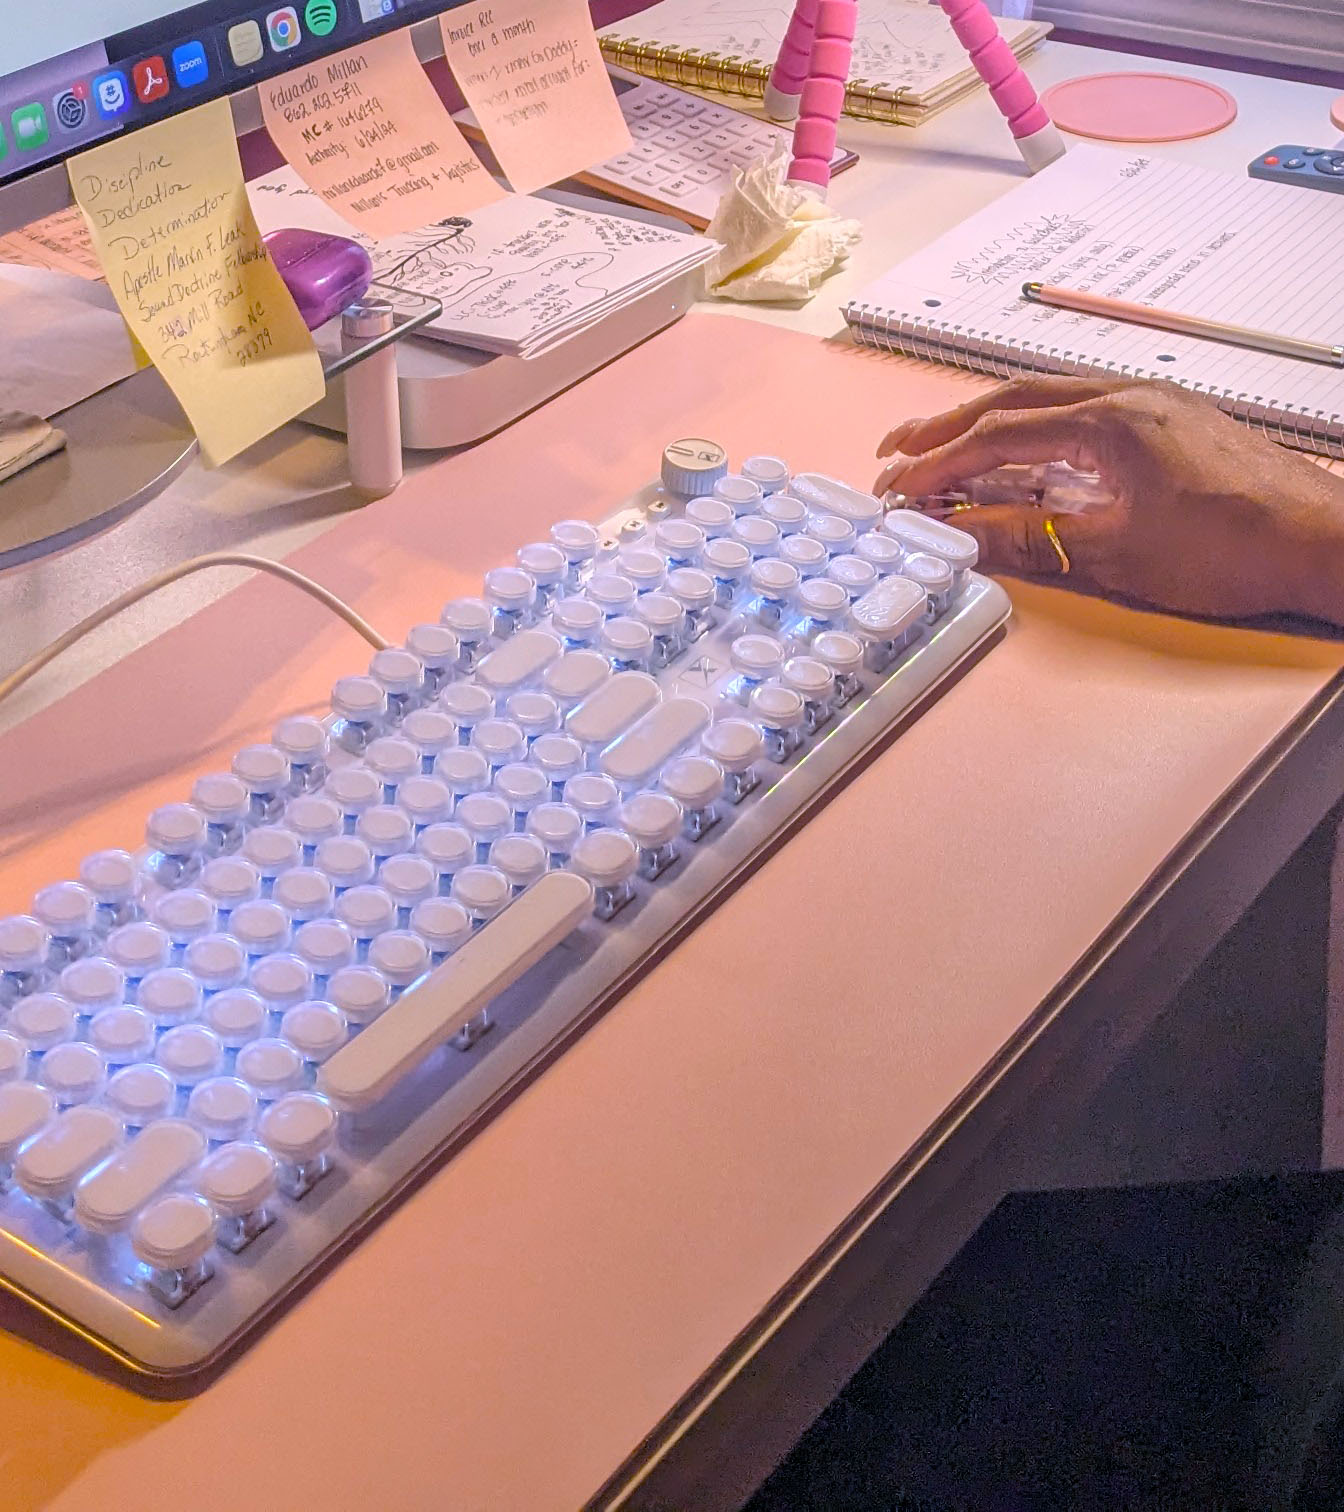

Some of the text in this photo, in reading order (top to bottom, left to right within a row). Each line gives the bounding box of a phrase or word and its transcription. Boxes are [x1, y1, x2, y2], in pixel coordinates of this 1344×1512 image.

[179, 57, 203, 73] zoom
[301, 123, 323, 144] MC
[81, 153, 173, 202] Discipline
[97, 181, 192, 229] Dedication
[109, 192, 232, 260] Determination
